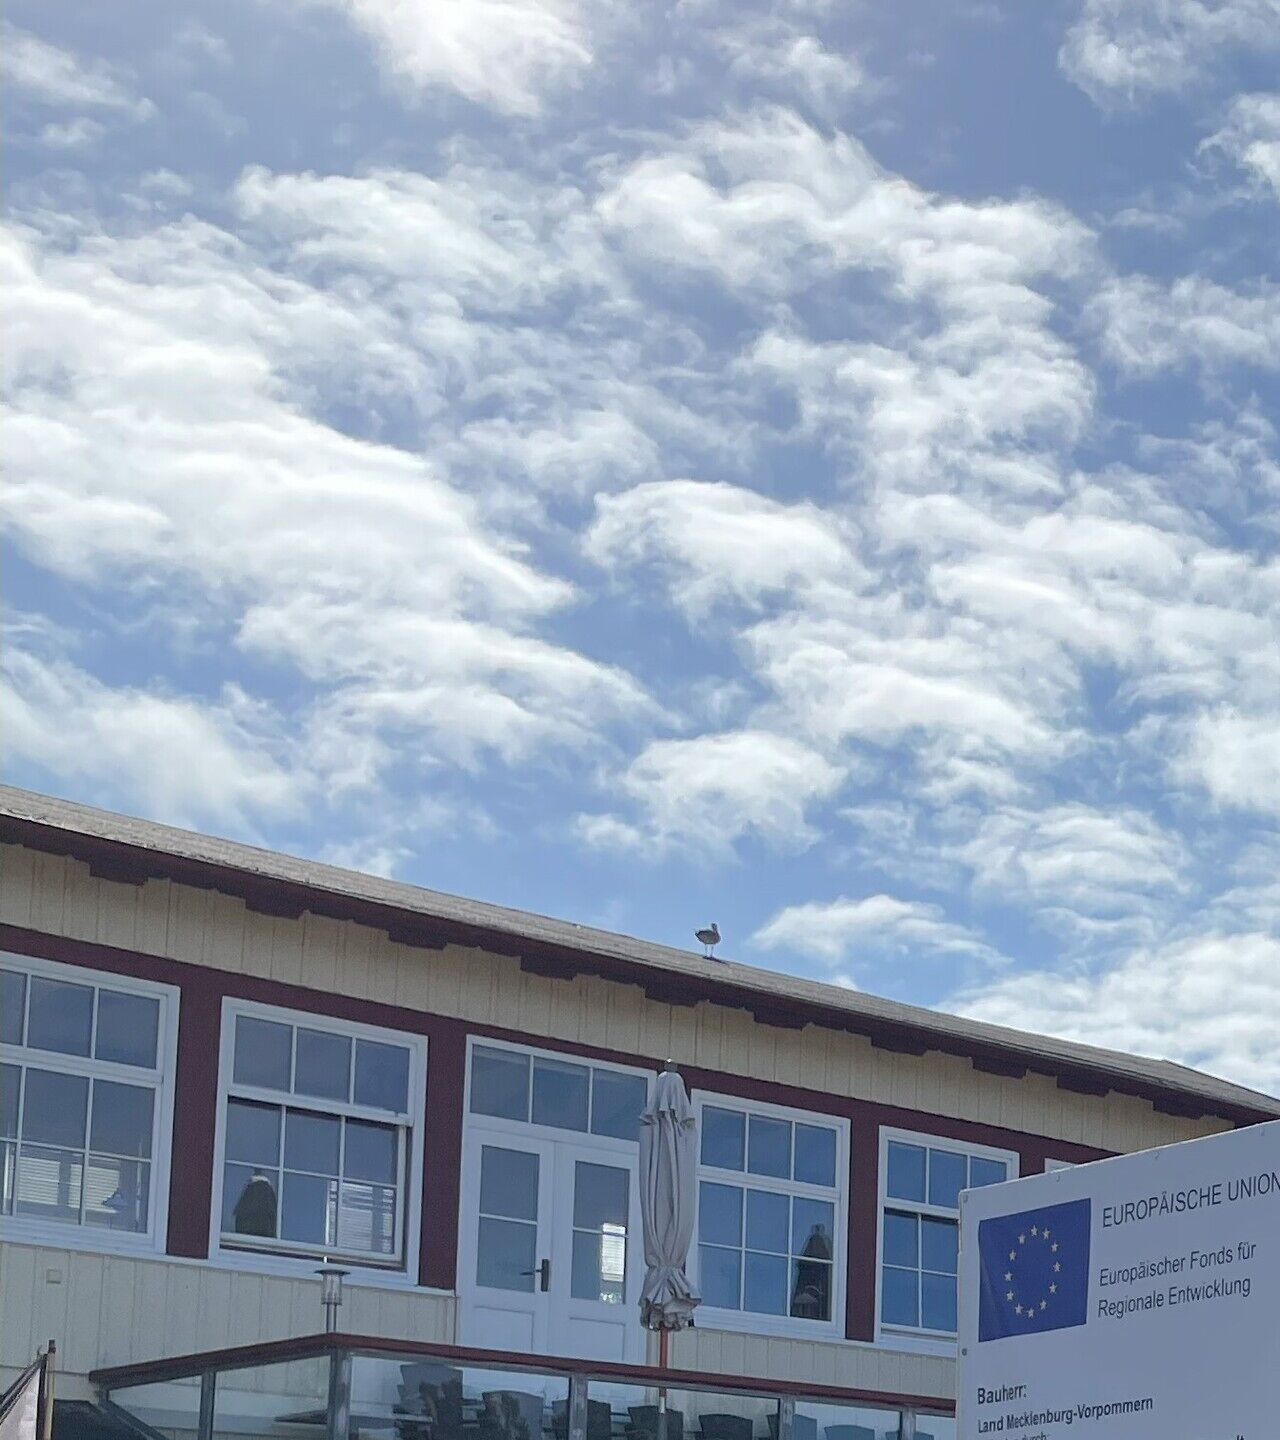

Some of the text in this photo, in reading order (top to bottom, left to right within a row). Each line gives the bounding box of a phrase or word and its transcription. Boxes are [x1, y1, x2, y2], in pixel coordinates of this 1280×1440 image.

[1102, 1183, 1223, 1229] EUROPÄISCHE
[1099, 1241, 1257, 1287] Europäischer Fonds für
[1097, 1277, 1251, 1320] Regionale Entwicklung
[977, 1397, 1153, 1434] Land Mecklenburg-Vorpommern
